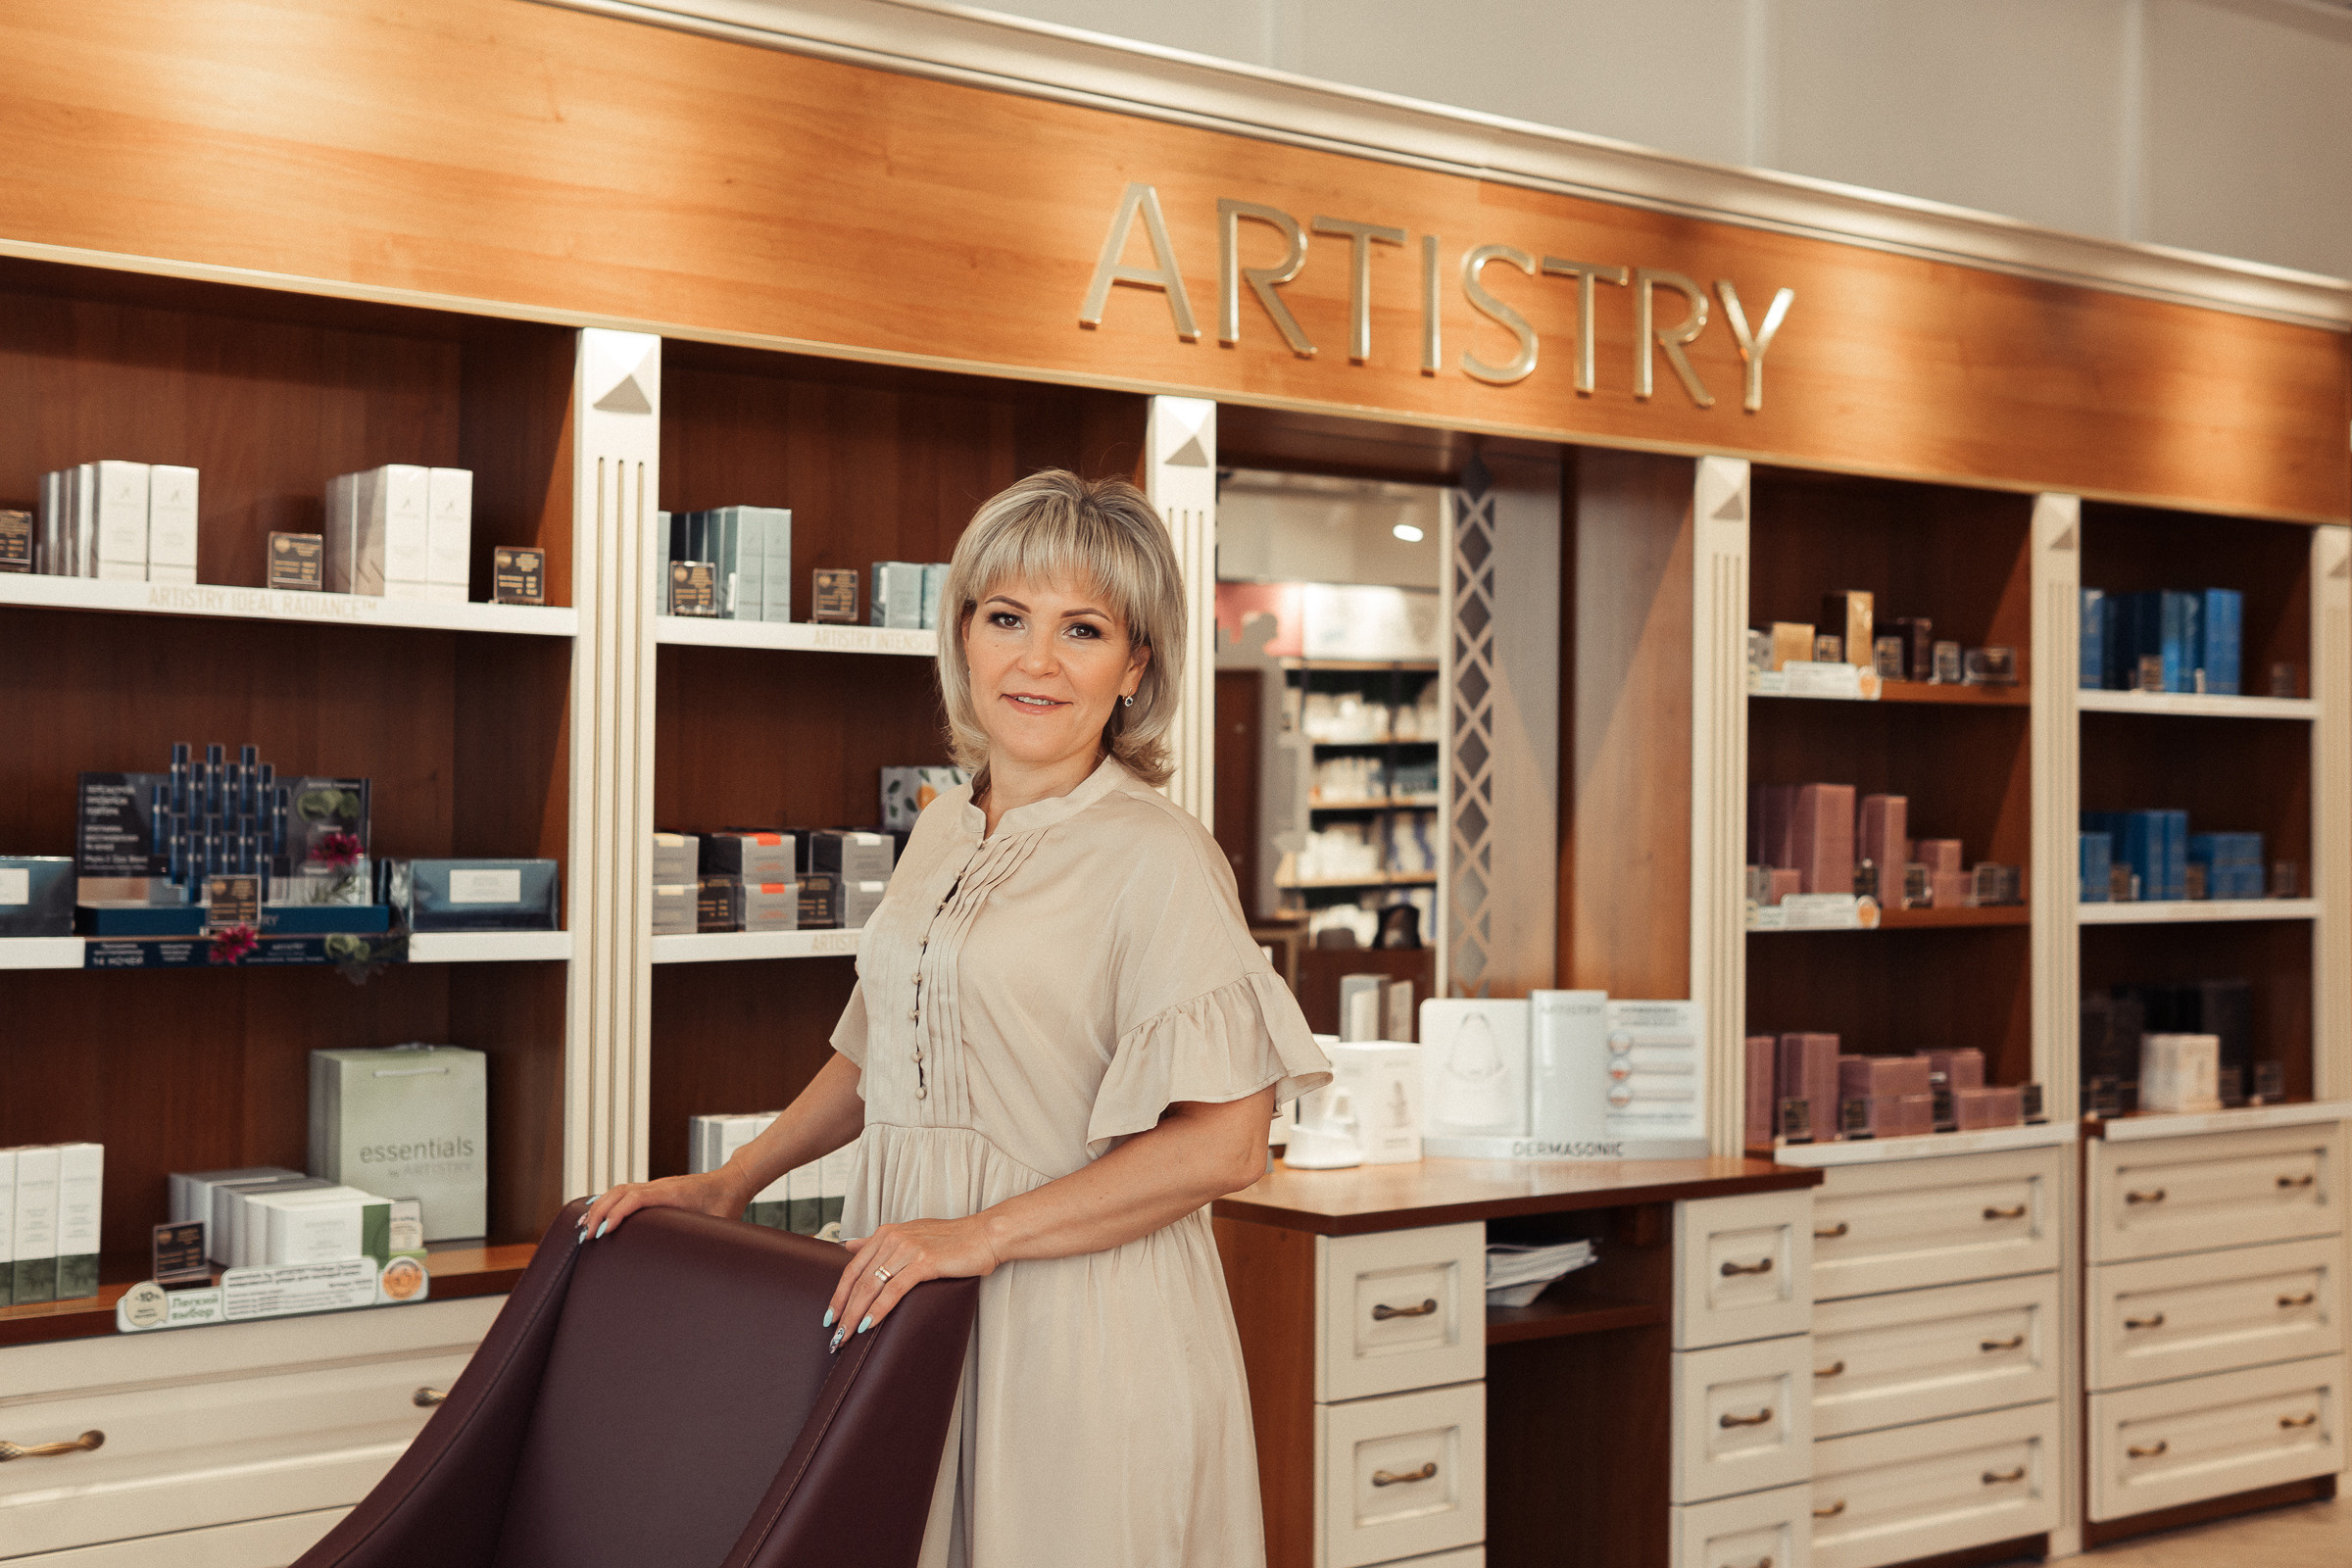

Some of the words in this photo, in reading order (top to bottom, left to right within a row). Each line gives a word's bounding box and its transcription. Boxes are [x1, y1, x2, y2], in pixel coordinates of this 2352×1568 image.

[1078, 181, 1795, 412] ARTISTRY
[148, 585, 224, 609] ARTISTRY
[228, 593, 275, 613] IDEAL
[359, 1136, 474, 1164] essentials
[1511, 1141, 1624, 1157] DERMASONIC
